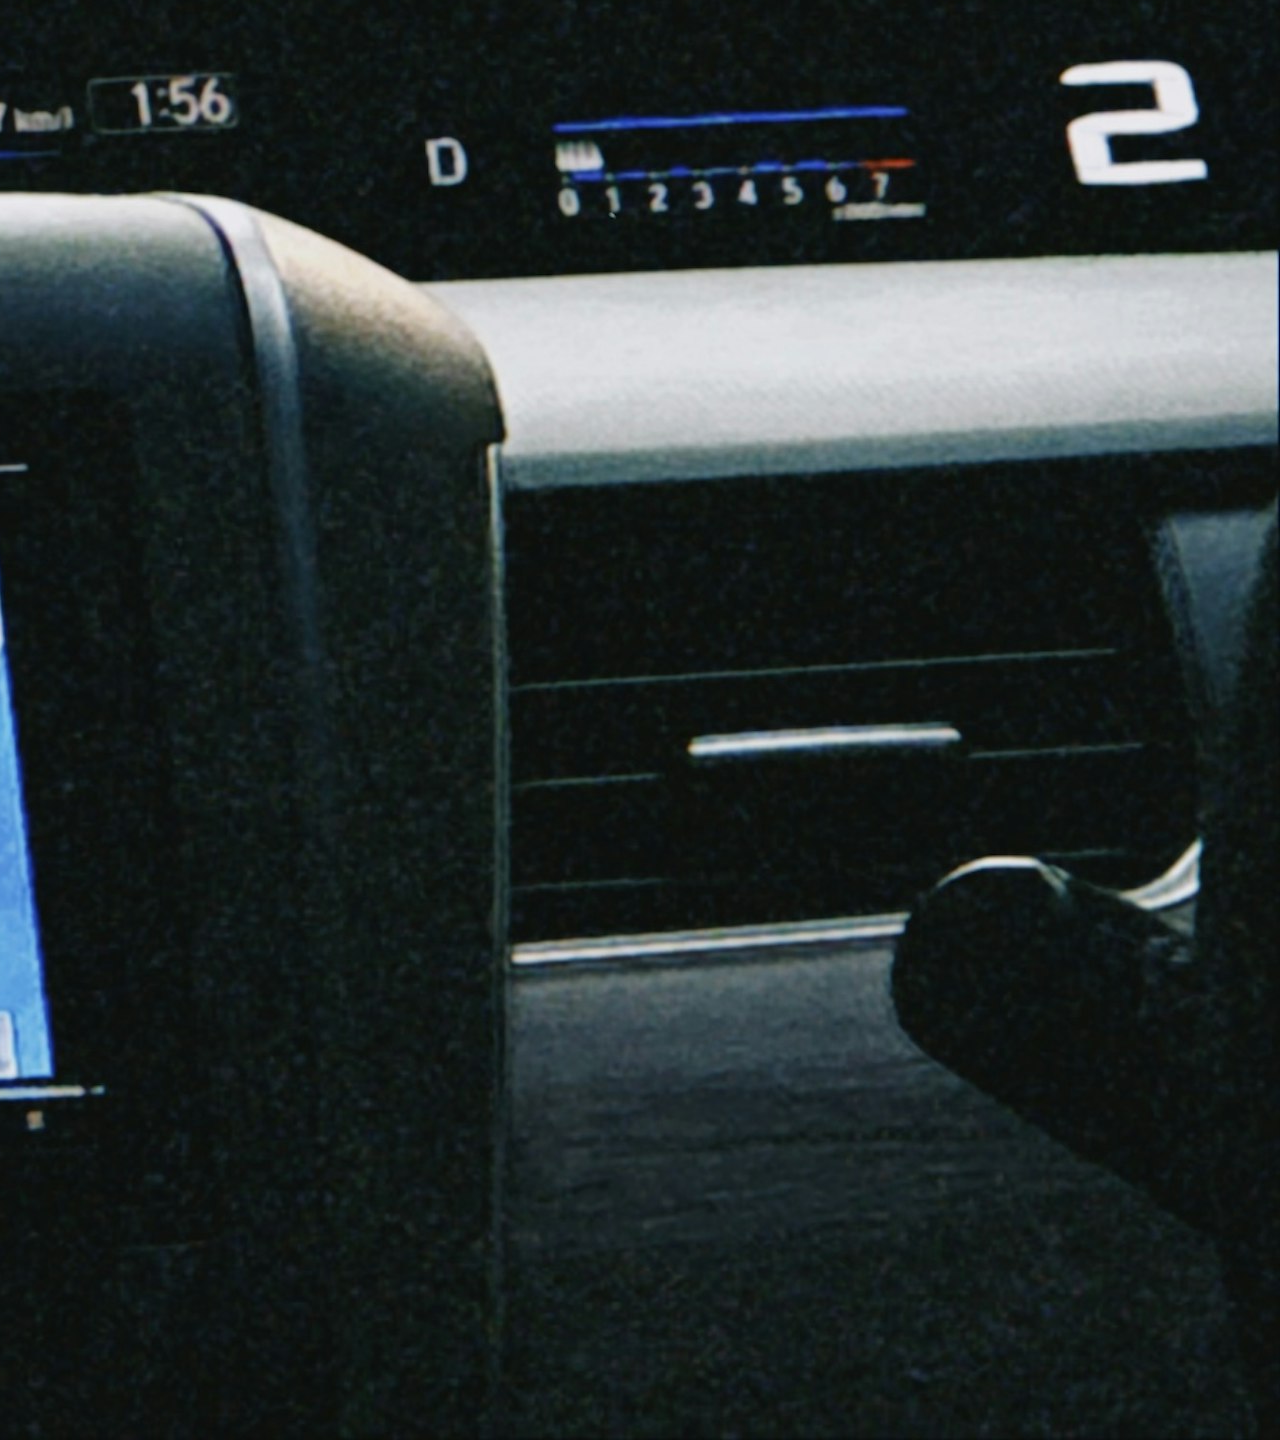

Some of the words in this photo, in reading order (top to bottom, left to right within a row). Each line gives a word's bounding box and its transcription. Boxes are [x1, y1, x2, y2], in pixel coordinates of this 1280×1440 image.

[131, 76, 231, 126] 1:56
[1058, 59, 1209, 186] 2
[426, 137, 468, 186] D
[558, 187, 580, 217] 0
[605, 185, 621, 213] 1
[648, 182, 669, 213] 2
[692, 180, 715, 210] 3
[738, 178, 758, 206] 4
[781, 176, 804, 205] 5
[826, 174, 846, 203] 6
[871, 171, 890, 199] 7
